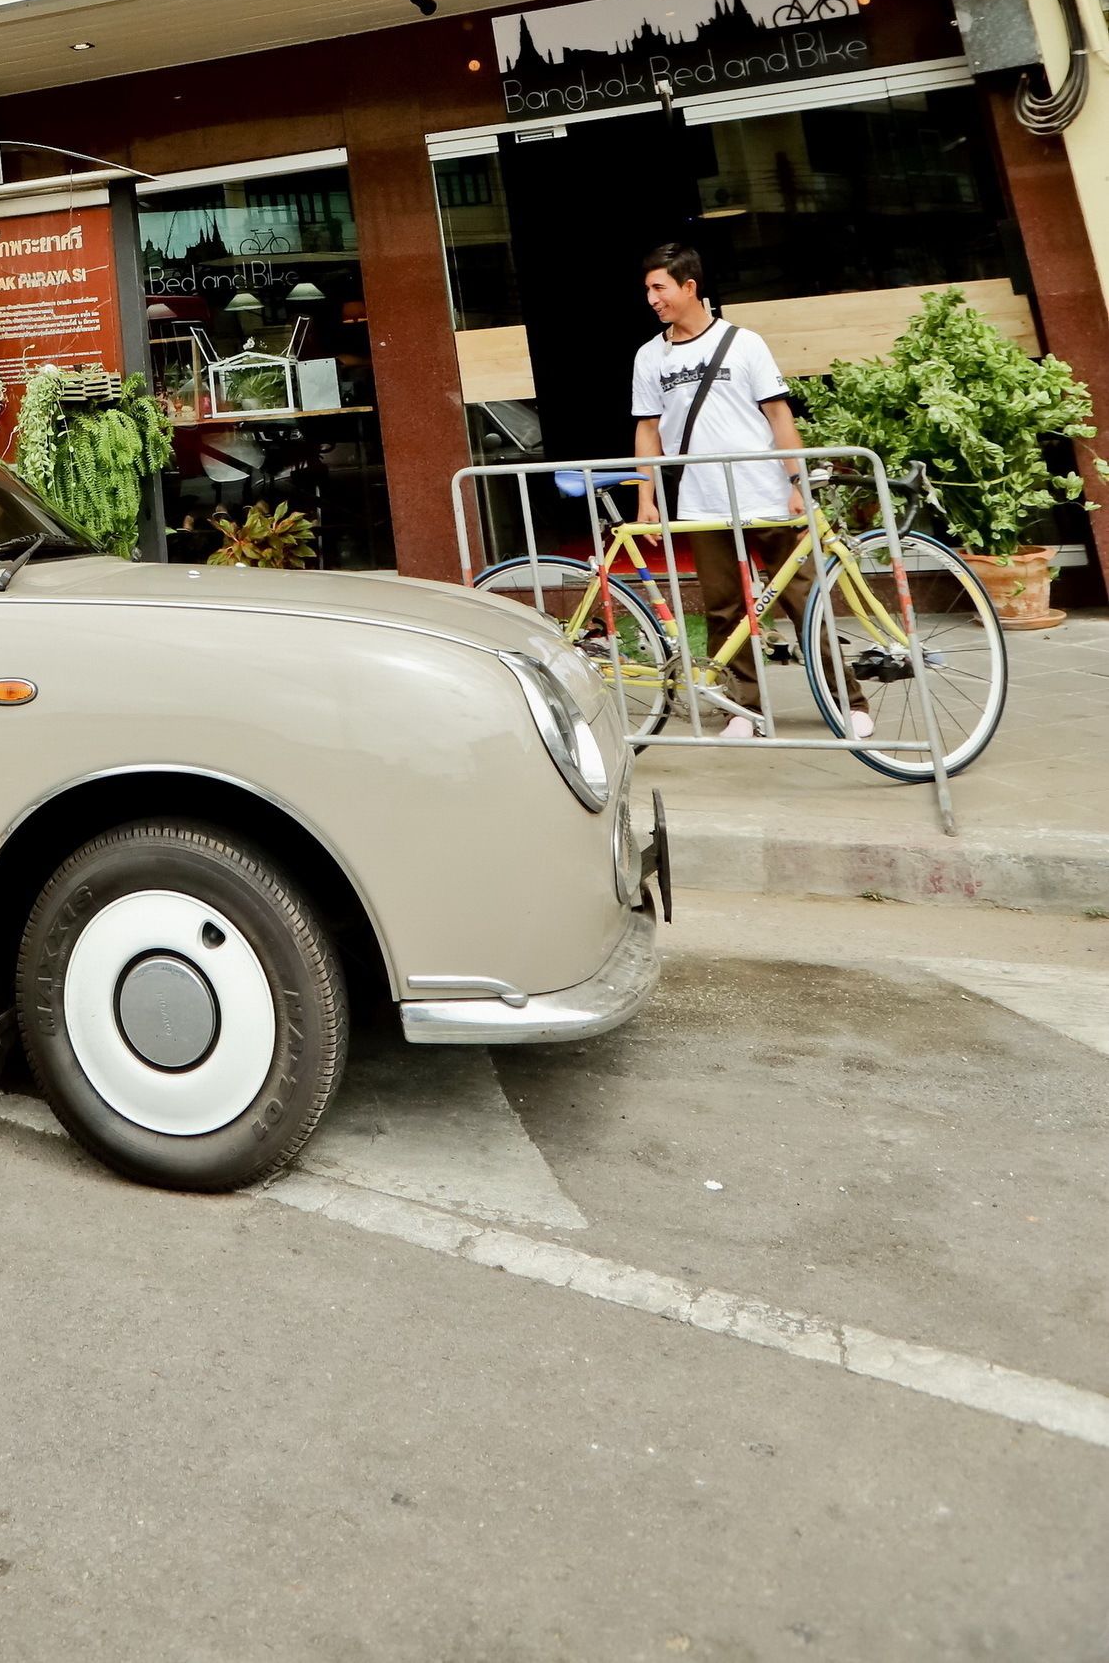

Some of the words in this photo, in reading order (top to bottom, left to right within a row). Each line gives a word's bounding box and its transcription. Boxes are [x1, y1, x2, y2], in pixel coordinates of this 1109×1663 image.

[503, 63, 646, 113] Bangkok
[649, 49, 717, 90] Bed
[724, 36, 789, 78] and
[793, 30, 868, 68] Bike
[17, 269, 71, 289] PHRAYA
[72, 268, 87, 282] SI
[148, 264, 196, 294] Bed
[202, 261, 248, 290] and
[251, 260, 300, 288] Bike
